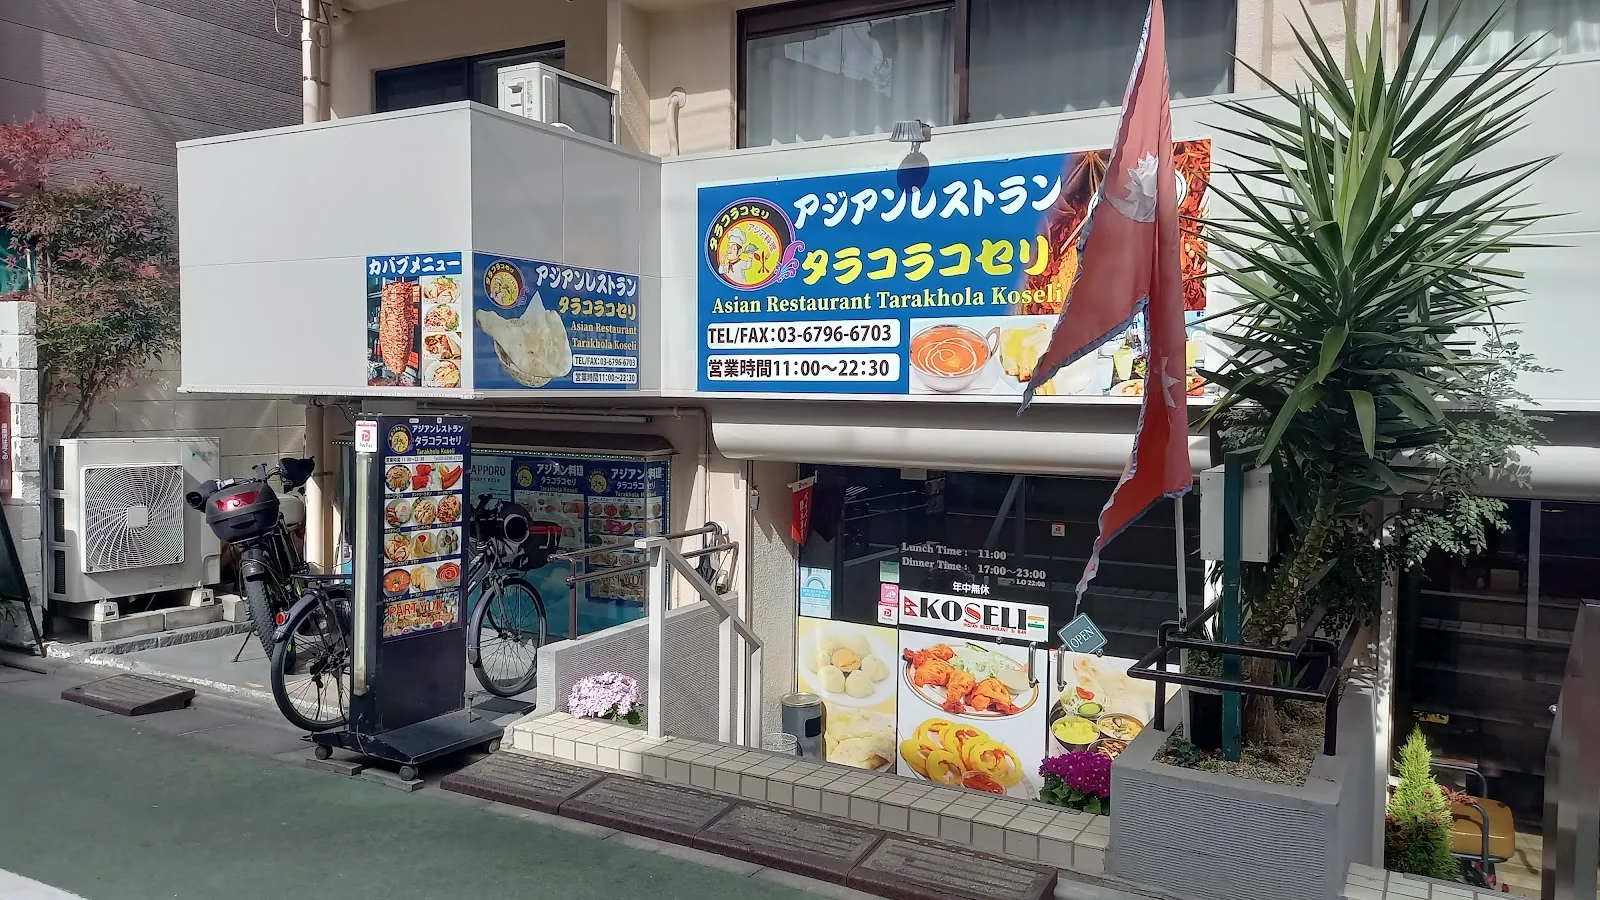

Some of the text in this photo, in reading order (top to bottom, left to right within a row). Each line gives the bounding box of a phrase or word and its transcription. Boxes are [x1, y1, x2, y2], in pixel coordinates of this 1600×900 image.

[793, 174, 1062, 230] アジアンレストラン
[710, 205, 770, 251] タラコラコセリ
[368, 255, 461, 275] カバブメニュー
[801, 235, 1049, 285] タラコラコセリ
[535, 264, 637, 297] アジアンレストラン
[711, 283, 1063, 314] Asian Restaurant Tarakhola Koseli
[558, 296, 637, 321] タラコラコセリ
[570, 321, 637, 335] Asian Restaurant
[708, 324, 892, 345] TEL/FAX:03-6796-6703
[571, 337, 637, 351] Tarakhola Koseli
[411, 424, 464, 433] アジアンレストラン
[414, 435, 462, 447] タラコラコセリ
[470, 464, 506, 477] APPORO
[541, 476, 577, 486] タラコラコセリ
[901, 542, 934, 554] Lunch
[936, 545, 962, 557] Time
[978, 549, 1007, 561] 11:00
[901, 556, 935, 568] Dinner
[937, 560, 962, 571] Time
[953, 581, 990, 596] 年中無休
[1027, 580, 1046, 588] 22:00
[920, 597, 1027, 631] KOSELI
[1070, 626, 1095, 648] OPEN
